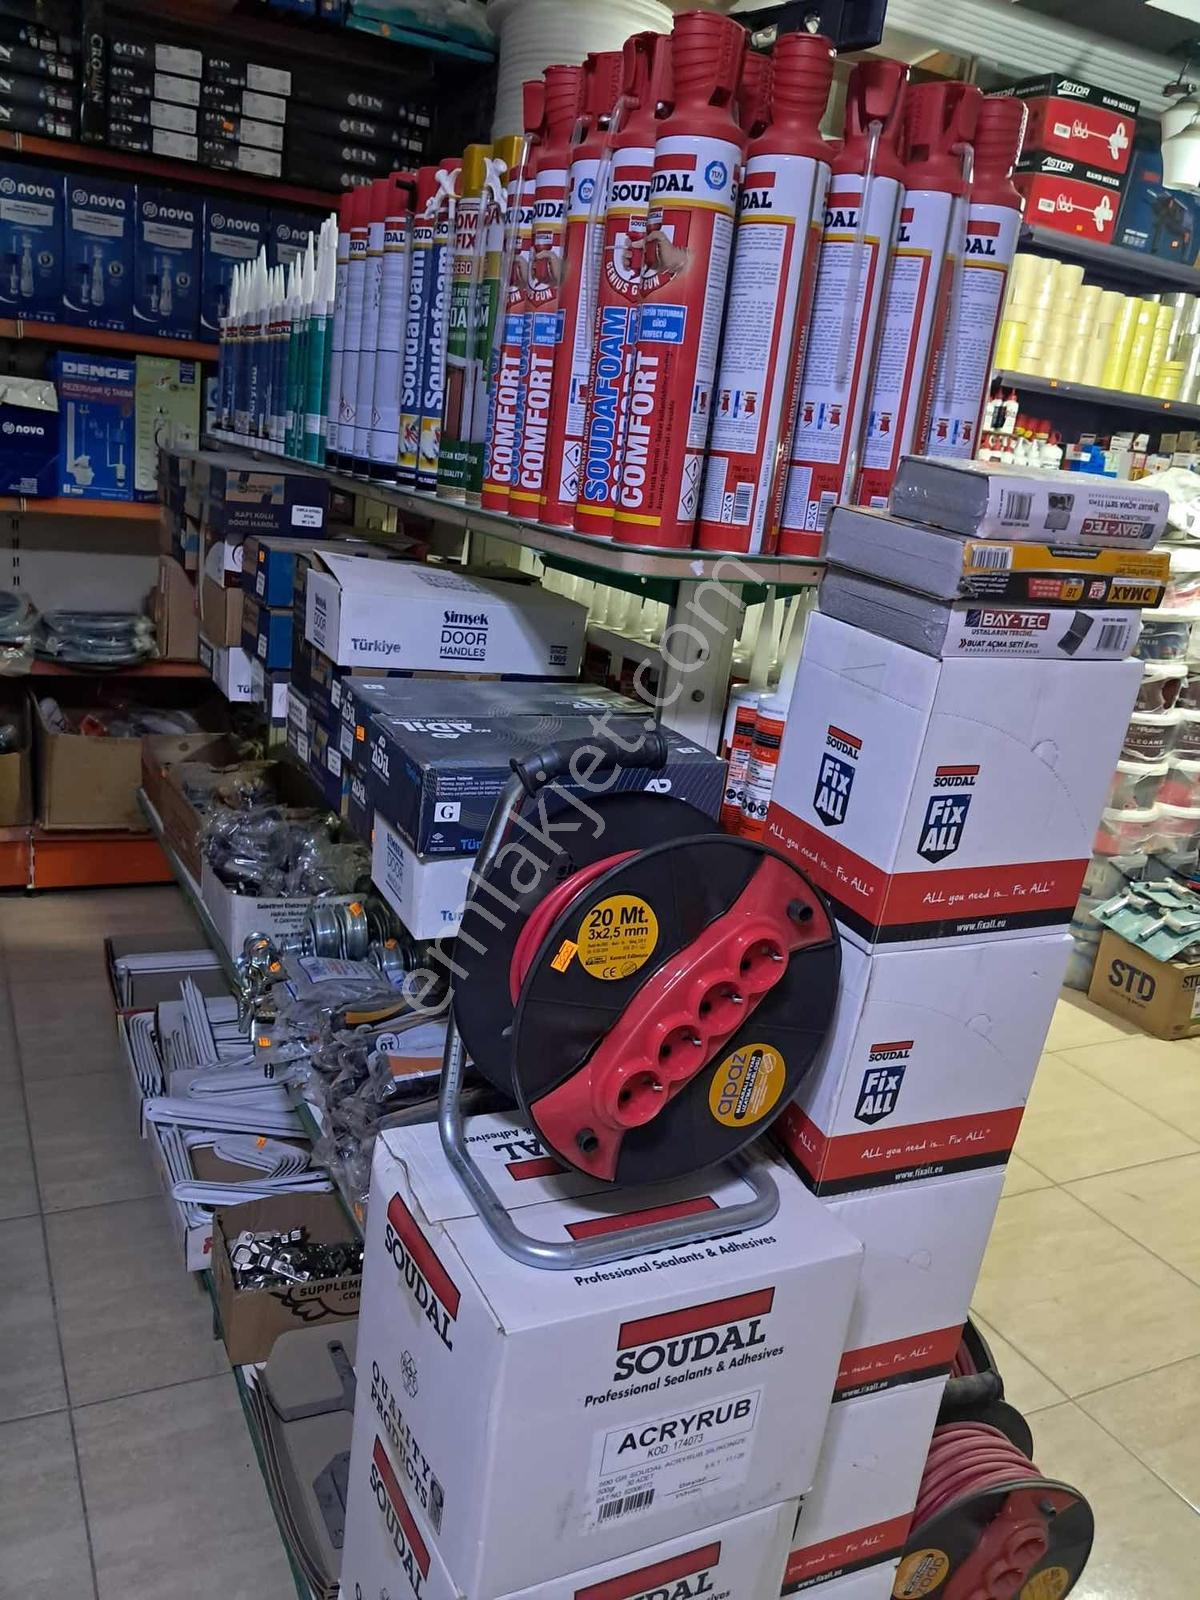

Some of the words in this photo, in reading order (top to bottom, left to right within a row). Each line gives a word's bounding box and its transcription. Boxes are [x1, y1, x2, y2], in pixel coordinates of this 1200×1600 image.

[1057, 80, 1091, 97] ASTOR
[1041, 157, 1074, 173] ASTOR
[18, 182, 55, 199] nova
[90, 194, 126, 210] nova
[159, 207, 194, 222] nova
[227, 218, 260, 233] nova
[292, 230, 320, 242] noa
[62, 361, 130, 381] DENGE
[583, 306, 629, 502] SOUDAFOAM
[491, 352, 522, 482] COMFORT
[520, 353, 555, 490] COMFORT
[16, 425, 45, 436] nova
[620, 351, 659, 508] COMFORT
[1084, 519, 1141, 537] BAY-TEC
[983, 613, 1048, 628] BAY-TEC
[351, 638, 401, 655] Türkiye
[441, 631, 487, 645] DOOR
[967, 640, 985, 648] BUAT
[986, 640, 1007, 649] AÇMA
[440, 646, 486, 657] HANDLES
[826, 736, 859, 761] SOUDAL
[821, 758, 850, 792] Fix
[933, 776, 976, 787] SOUDAL
[440, 805, 454, 819] G
[816, 790, 843, 821] ALL
[929, 799, 966, 825] Fix
[769, 823, 785, 840] ALL
[921, 827, 958, 852] ALL
[923, 891, 946, 903] ALL
[968, 887, 990, 900] need
[1013, 884, 1026, 895] Fix
[589, 908, 614, 927] 20
[620, 906, 649, 925] Mt.
[957, 919, 1006, 932] www.fixall.eu
[588, 926, 621, 940] 3x2,5
[625, 927, 648, 937] mm
[1108, 959, 1156, 1002] STD
[868, 1050, 910, 1062] SOUDAL
[718, 1053, 748, 1116] apaz
[864, 1071, 899, 1094] Fix
[858, 1093, 894, 1117] ALL
[463, 1130, 519, 1144] Adhesives
[861, 1148, 883, 1159] ALL
[906, 1140, 926, 1152] need
[895, 1165, 944, 1181] www.fixall.eu
[574, 1262, 652, 1287] Professional
[652, 1250, 705, 1270] Sealants
[706, 1248, 716, 1258] &
[720, 1233, 777, 1256] Adhesives
[300, 1280, 362, 1297] SUPPLEM
[384, 1223, 453, 1352] SOUDAL
[613, 1319, 766, 1382] SOUDAL
[584, 1378, 661, 1408] Professional
[663, 1365, 714, 1388] Sealants
[716, 1361, 725, 1373] &
[728, 1345, 784, 1370] Adhesives
[372, 1361, 432, 1480] QUALITY
[617, 1398, 752, 1454] ACRYRUB
[370, 1381, 428, 1510] PRODUCTS
[673, 1433, 704, 1451] 174073
[369, 1462, 423, 1600] SOUDAL
